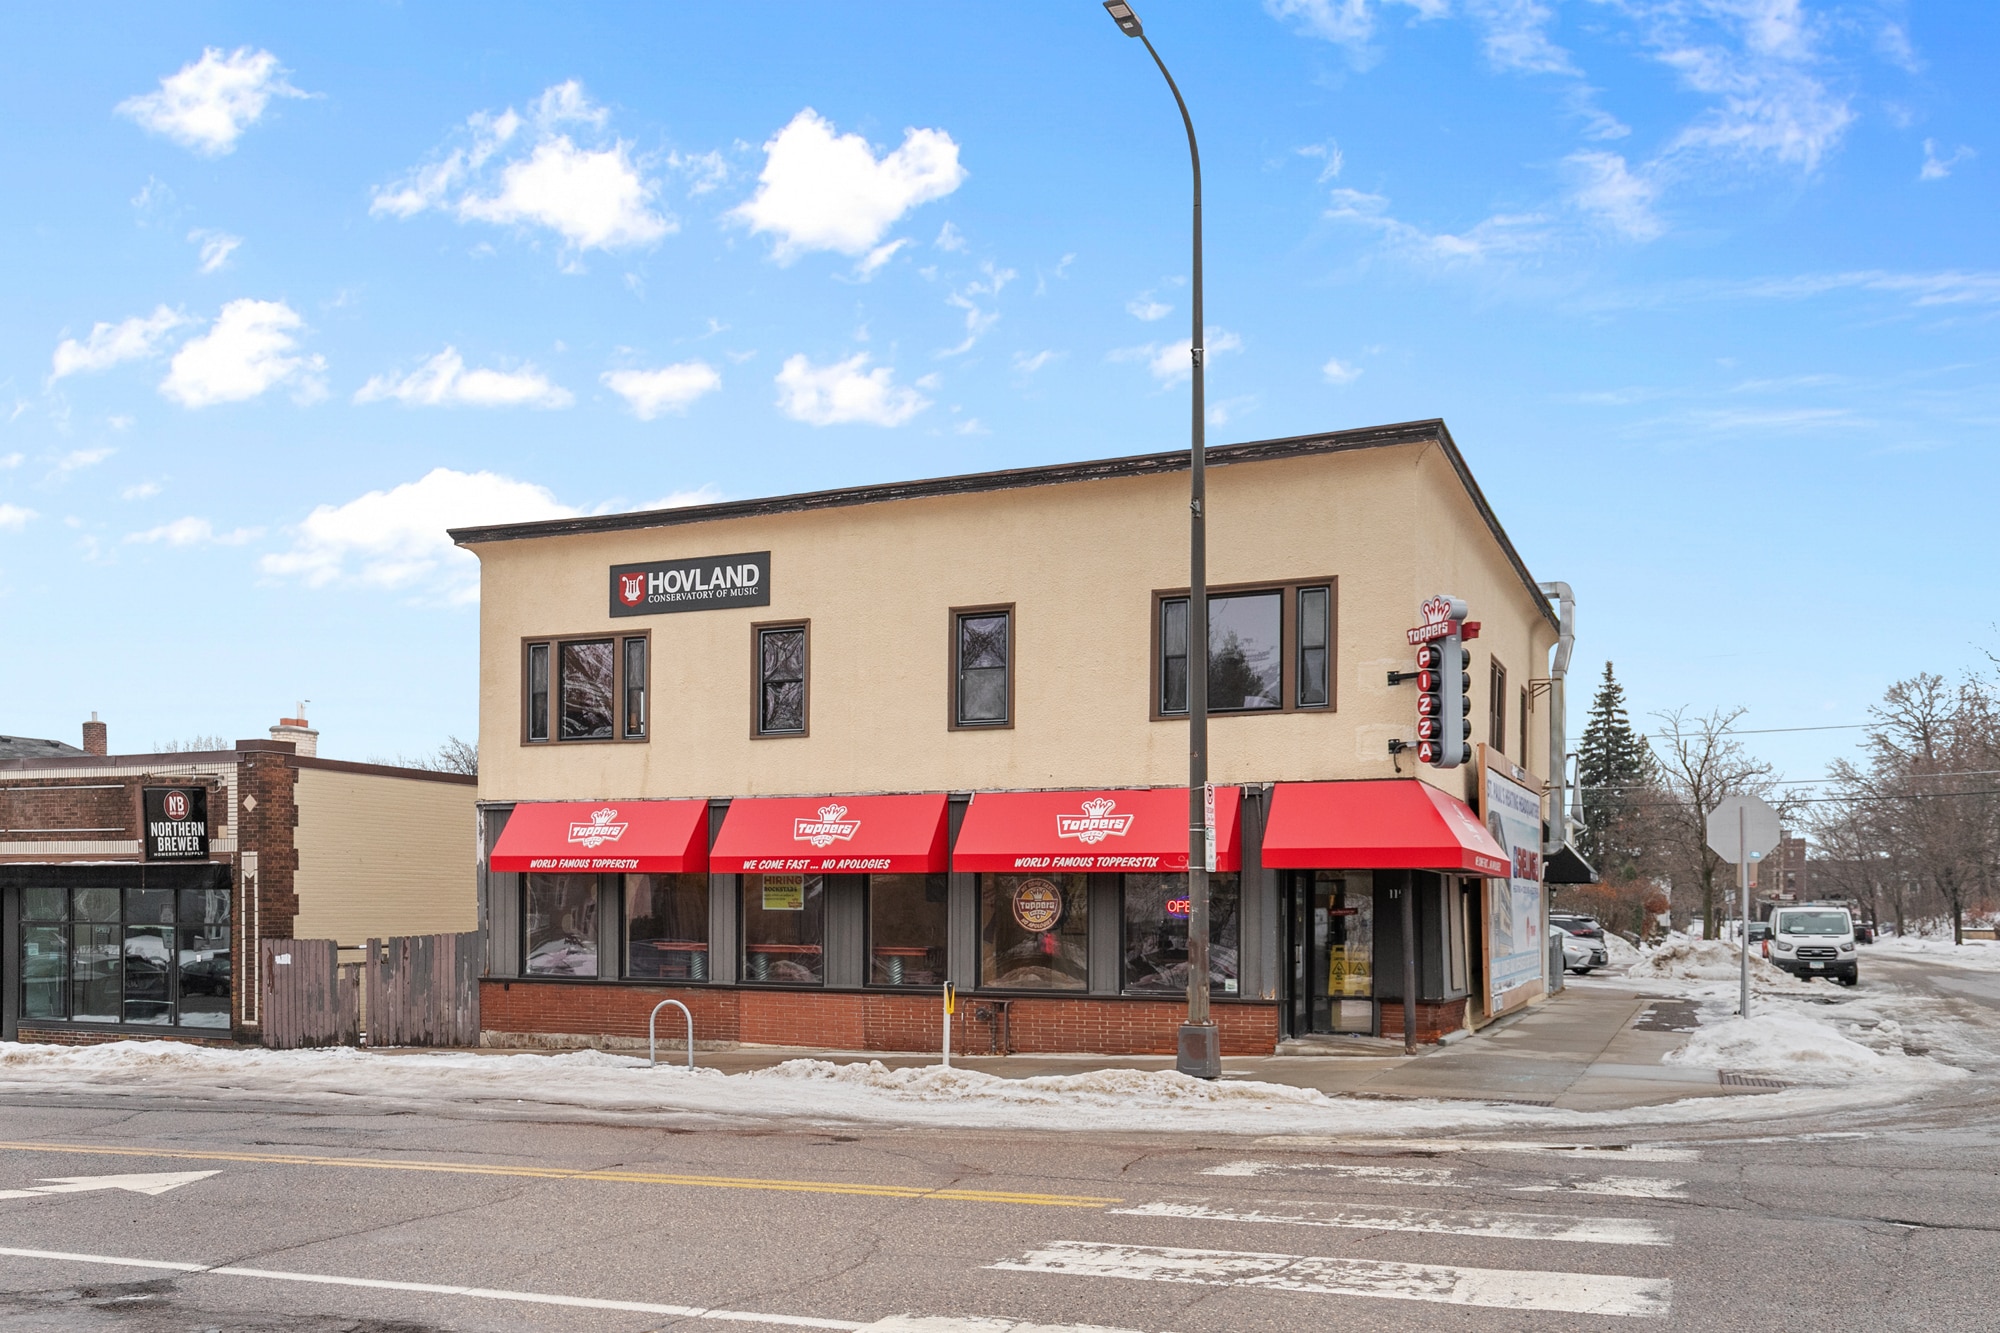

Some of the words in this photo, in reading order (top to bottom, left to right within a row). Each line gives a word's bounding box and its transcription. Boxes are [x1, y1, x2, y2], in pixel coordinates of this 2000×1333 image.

[648, 564, 760, 595] HOVLAND
[648, 591, 714, 603] CONSERVATORY
[717, 590, 728, 598] OF
[730, 587, 759, 597] MUSIC
[1418, 651, 1433, 758] PIZZA
[168, 796, 185, 811] NB
[150, 821, 205, 837] NORTHERN
[157, 836, 200, 852] BREWER
[529, 859, 558, 869] WORLD
[558, 859, 591, 869] FAMOUS
[591, 859, 639, 869] TOPPERSTIX
[742, 859, 758, 870] WE
[758, 859, 785, 870] COME
[821, 859, 836, 870] NO
[836, 859, 891, 870] APOLOGIES
[1014, 856, 1050, 868] WORLD
[1051, 856, 1095, 868] FAMOUS
[1096, 856, 1160, 869] TOPPERSTIX
[763, 875, 803, 885] HIRING
[1166, 899, 1190, 913] OPE
